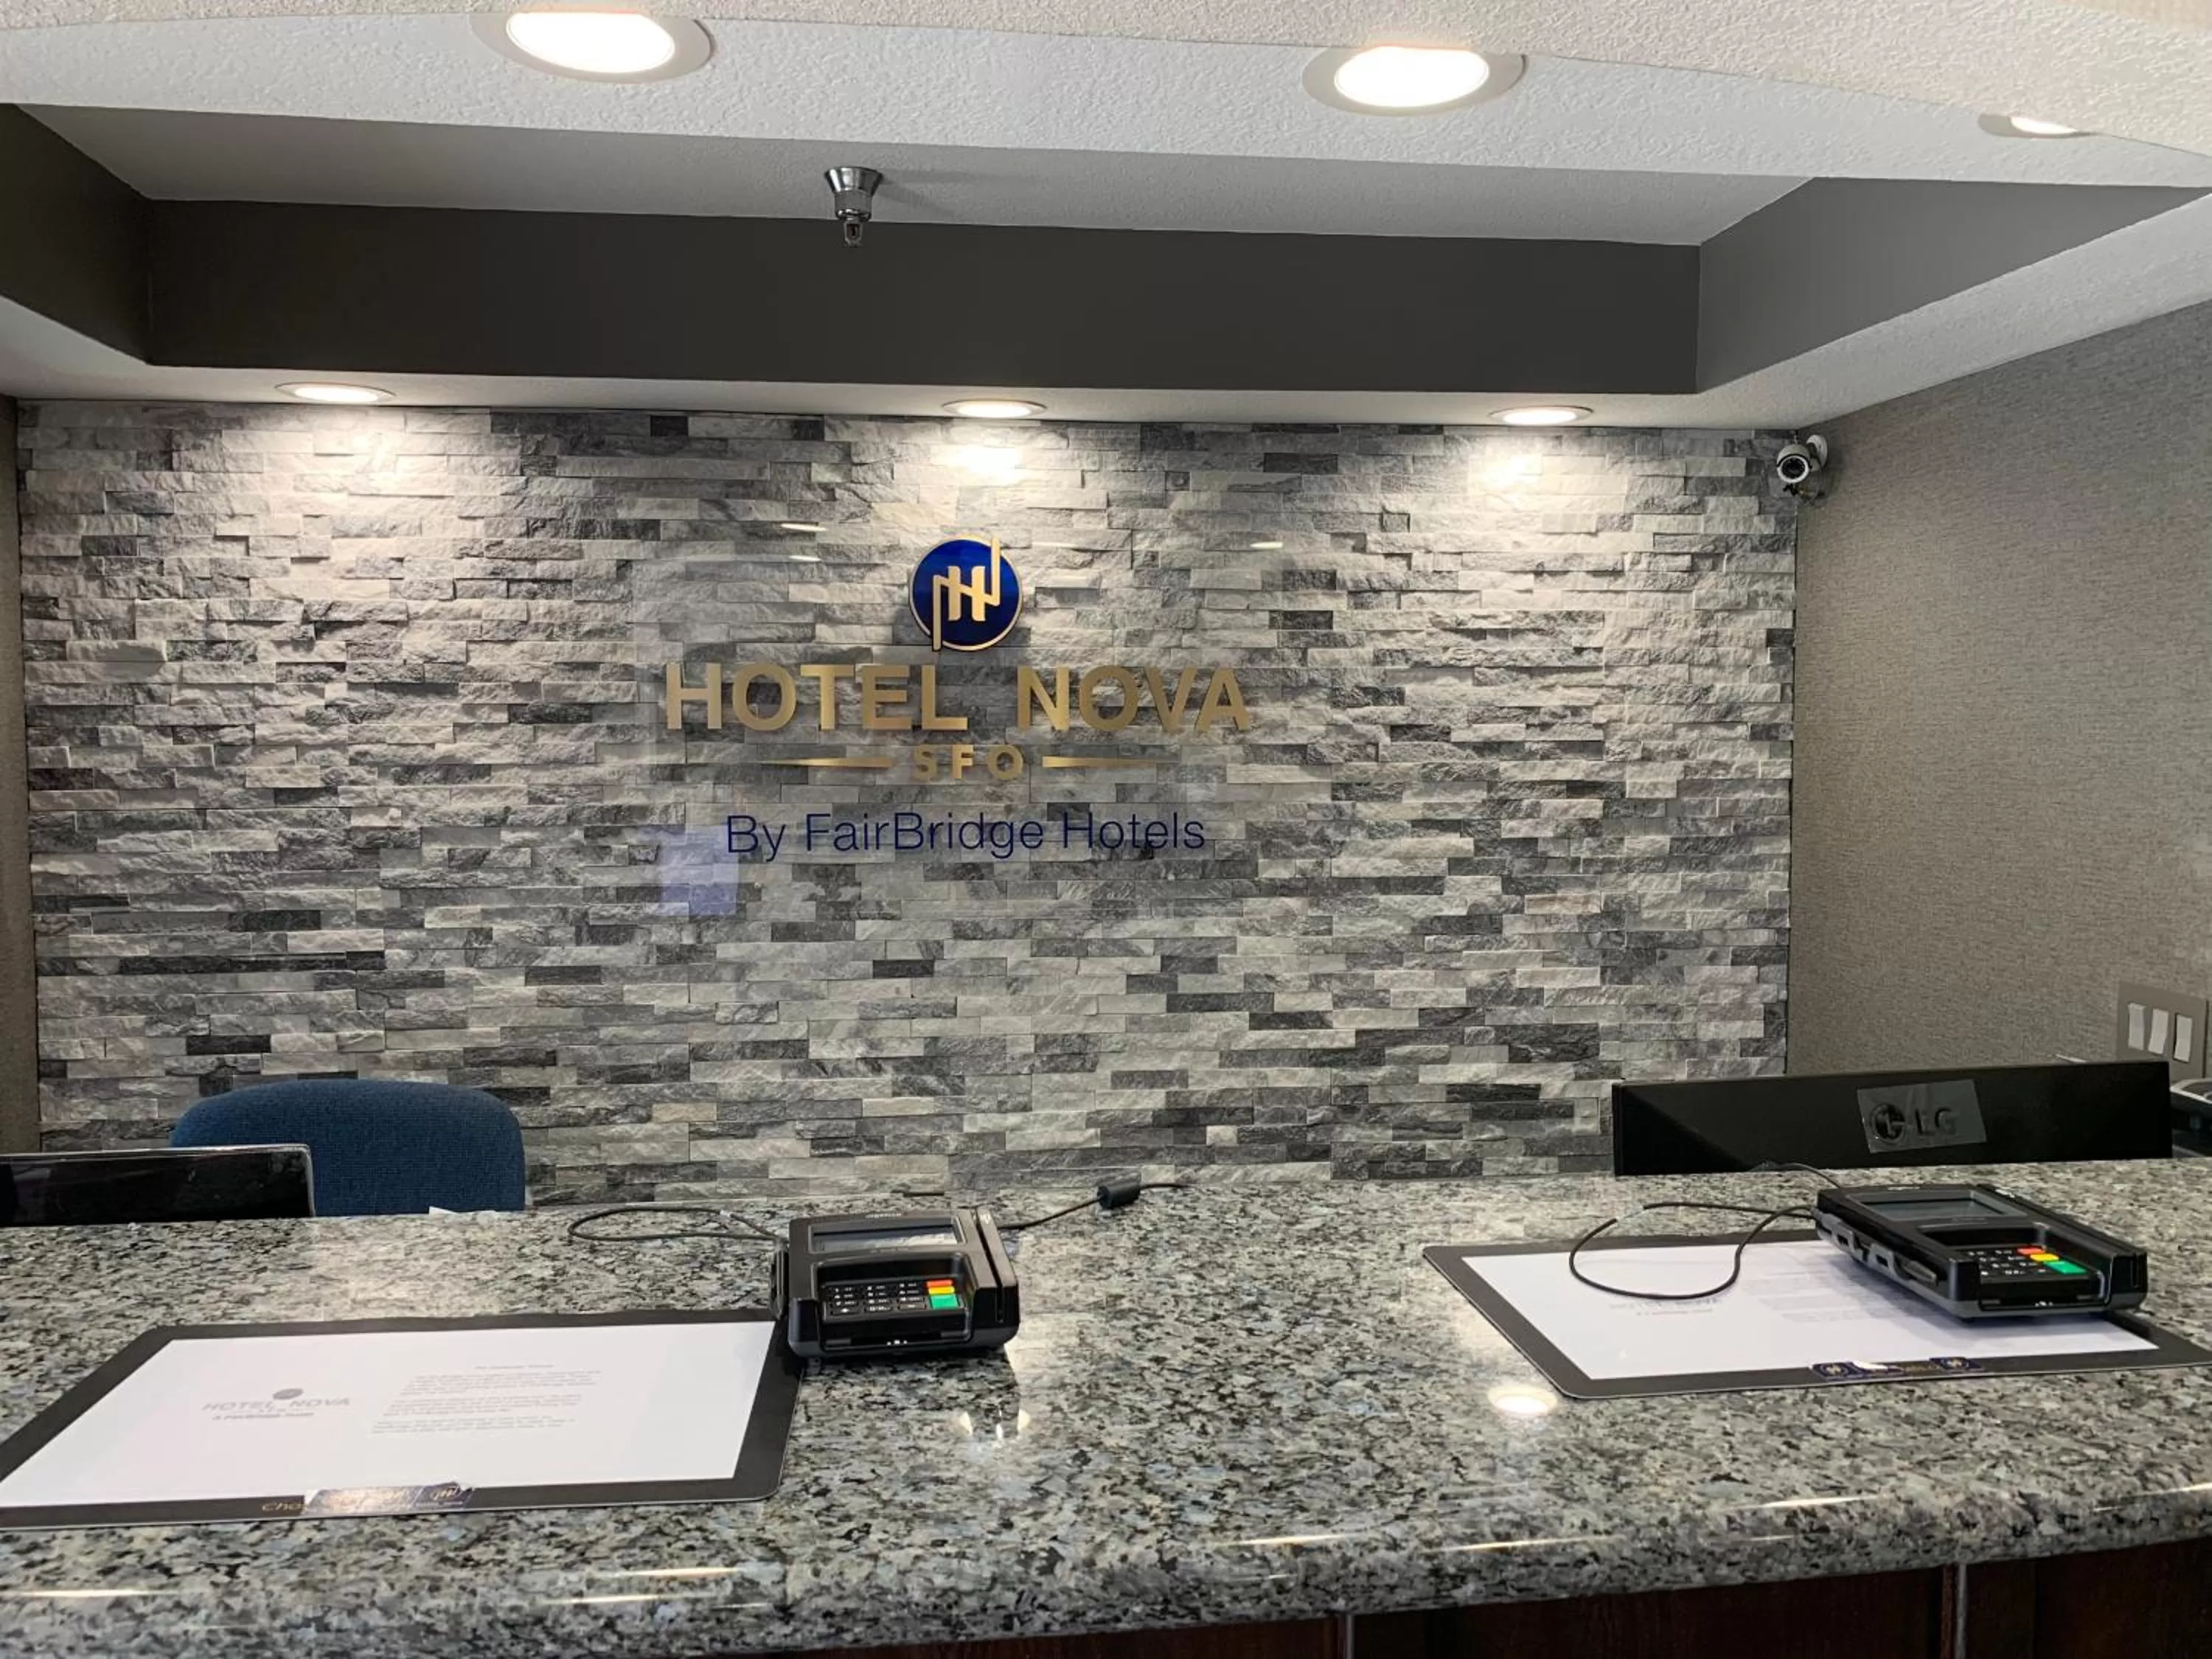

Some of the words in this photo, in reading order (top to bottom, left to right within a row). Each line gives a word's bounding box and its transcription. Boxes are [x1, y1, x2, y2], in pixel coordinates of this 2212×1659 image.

[666, 663, 968, 731] HOTEL
[1016, 665, 1251, 732] NOVA
[913, 743, 1025, 782] SFO
[726, 813, 787, 862] By
[805, 811, 1045, 860] FairBridge
[1062, 810, 1206, 850] Hotels
[1915, 1107, 1958, 1136] LG
